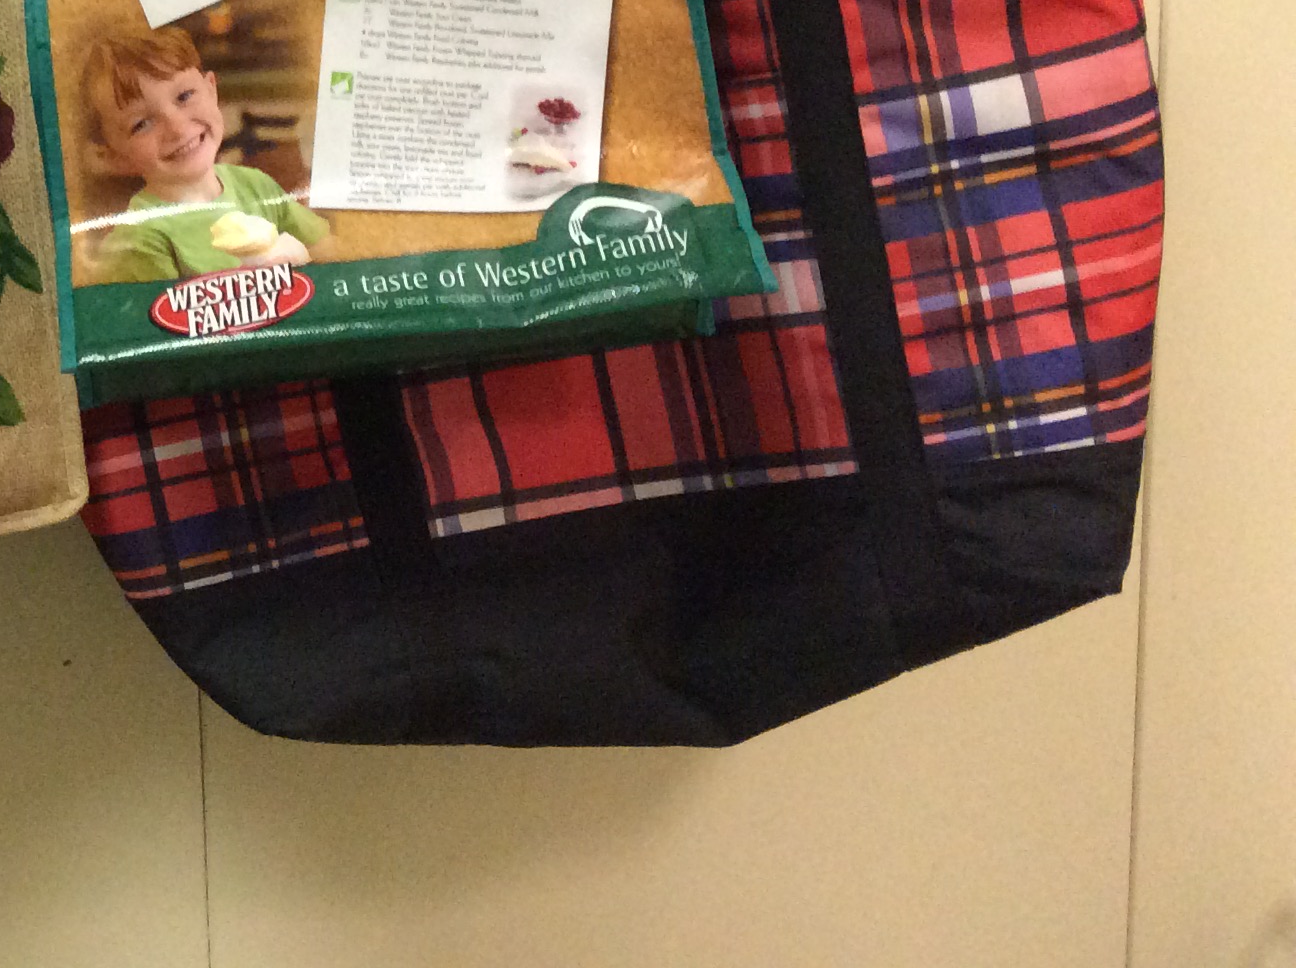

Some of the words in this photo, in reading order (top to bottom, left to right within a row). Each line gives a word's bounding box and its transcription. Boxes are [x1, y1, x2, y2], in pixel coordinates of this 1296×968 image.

[333, 279, 350, 297] a
[360, 270, 429, 295] taste
[439, 262, 467, 288] of
[474, 246, 587, 289] Western
[596, 223, 689, 263] Family
[352, 295, 389, 310] really
[394, 294, 430, 310] great
[435, 292, 487, 305] recipes
[491, 288, 524, 304] from
[529, 283, 553, 299] our
[557, 268, 610, 290] kitchen
[615, 265, 632, 279] to
[636, 251, 683, 276] yours!
[167, 263, 293, 312] WESTERN
[188, 290, 278, 337] FAMILY
